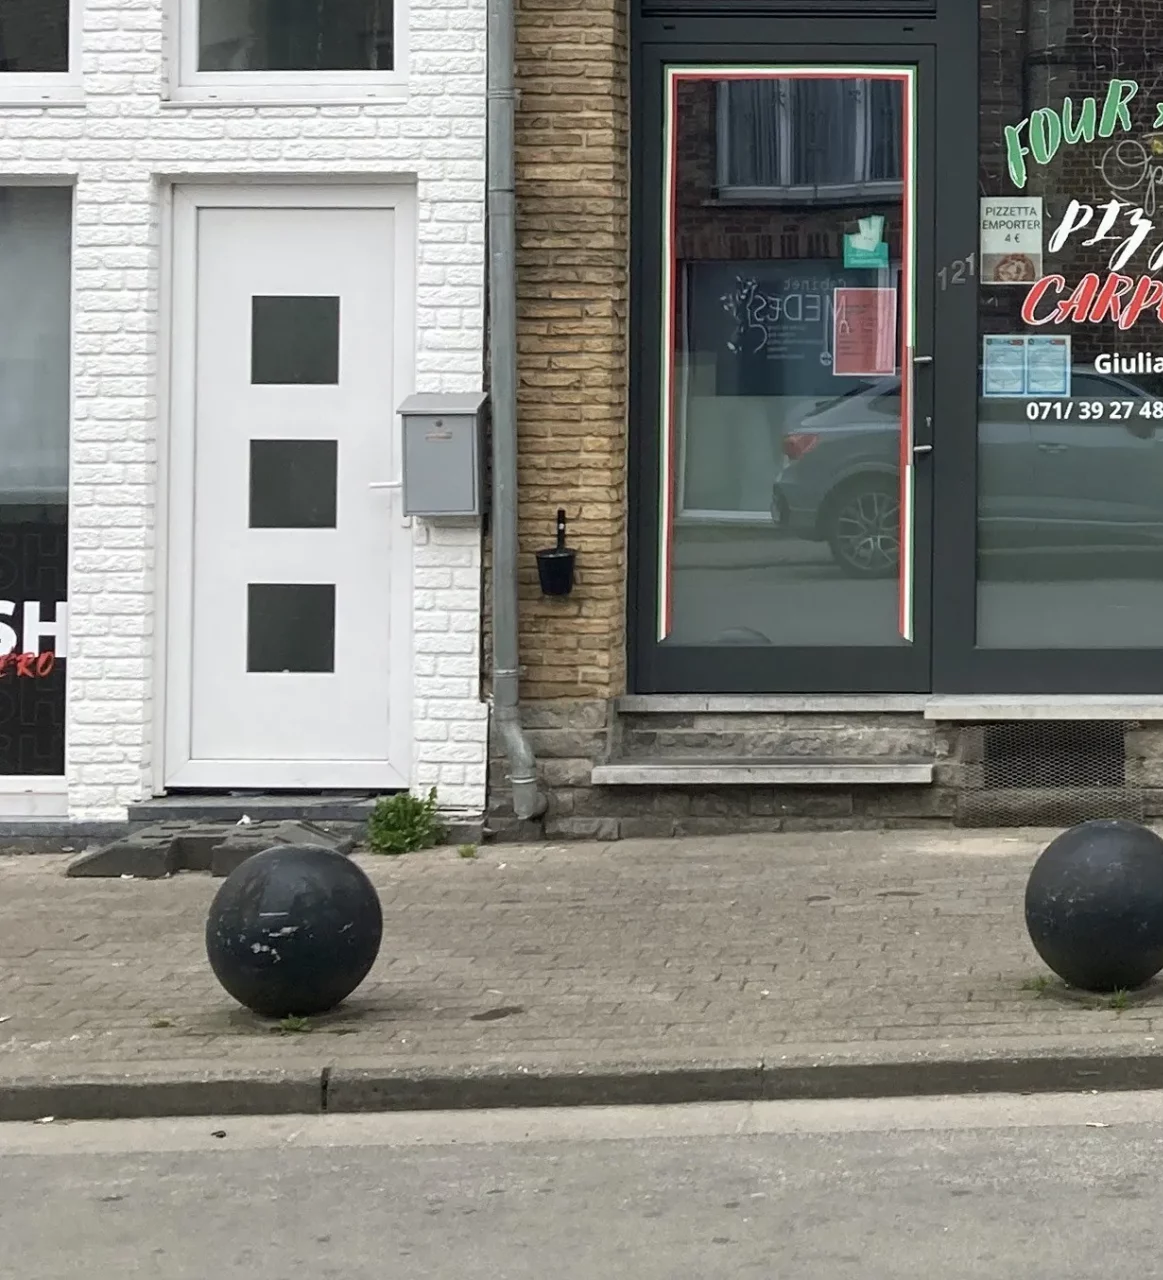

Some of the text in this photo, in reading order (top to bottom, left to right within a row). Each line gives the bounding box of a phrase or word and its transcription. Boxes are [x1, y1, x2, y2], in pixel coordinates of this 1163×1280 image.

[1004, 78, 1139, 189] FOUR
[985, 206, 1038, 217] PIZZETTA
[982, 220, 1041, 230] EMPORTER
[1004, 233, 1021, 243] 4 €
[937, 252, 975, 291] 121
[1026, 402, 1073, 420] 071/
[1078, 402, 1104, 420] 39
[1109, 402, 1134, 420] 27
